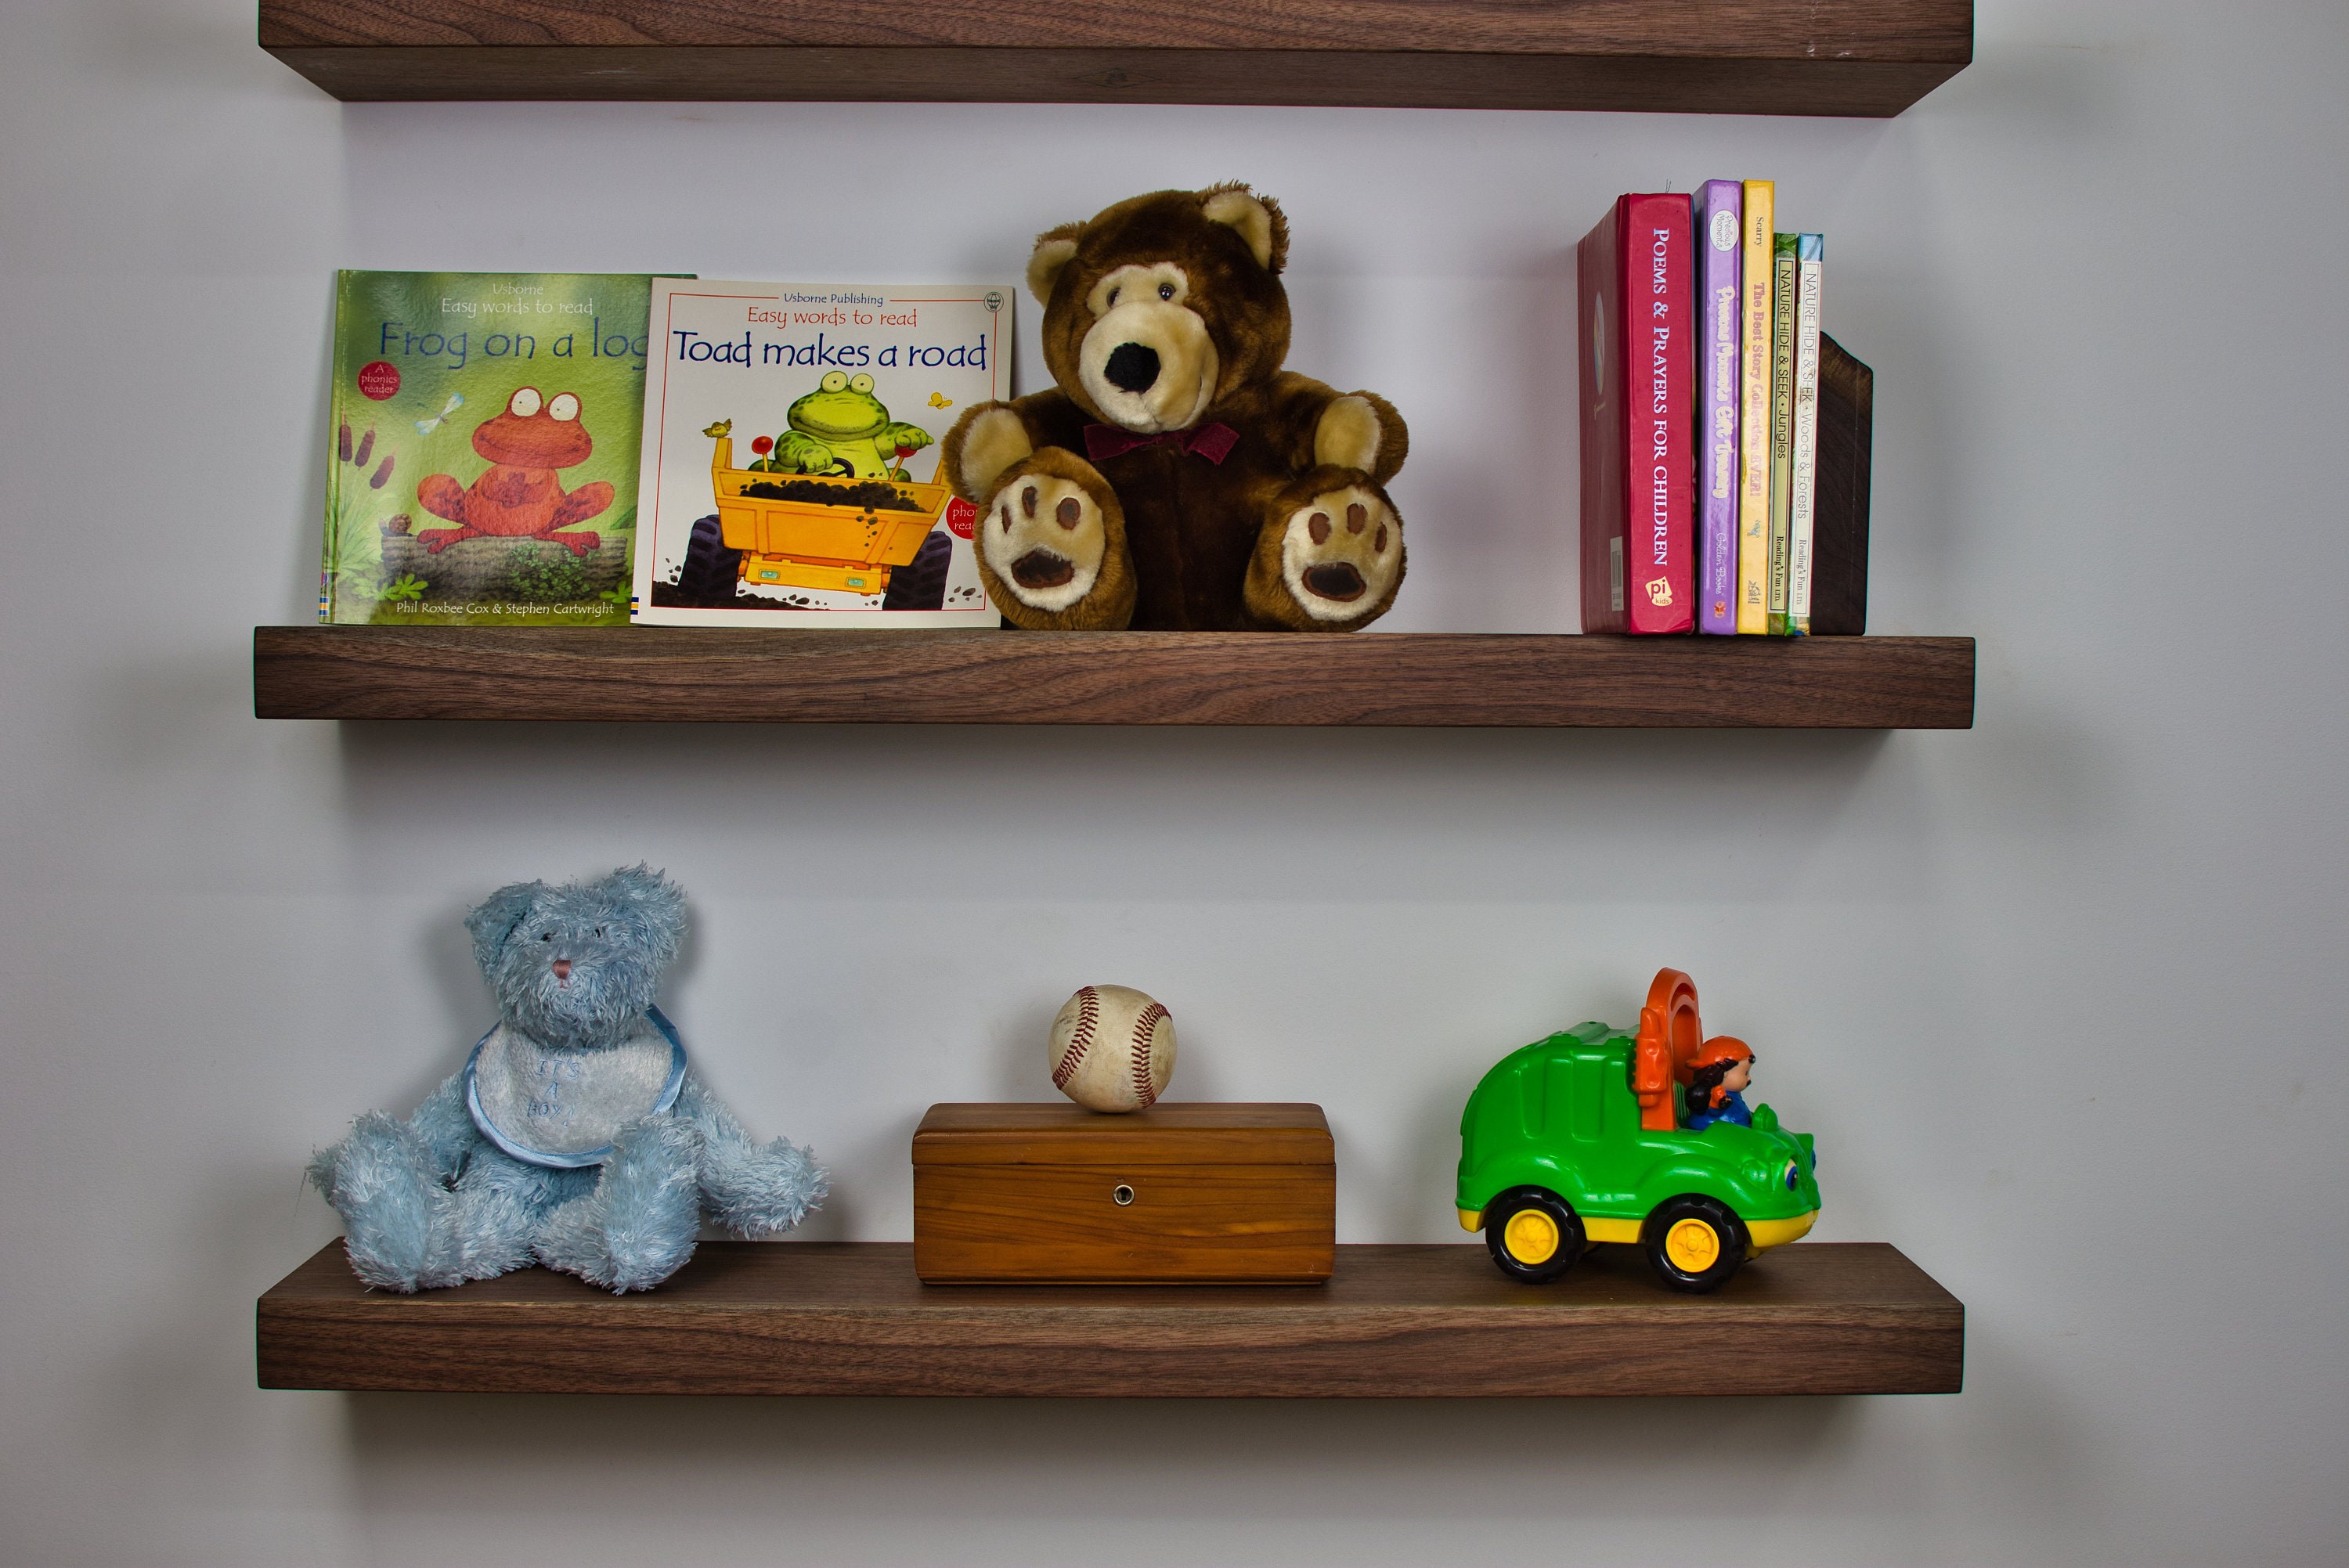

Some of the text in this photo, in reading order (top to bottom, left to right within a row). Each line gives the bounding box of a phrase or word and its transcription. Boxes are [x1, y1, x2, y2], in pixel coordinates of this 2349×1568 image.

[1716, 214, 1725, 248] Moments
[1754, 217, 1764, 247] Scarry
[493, 283, 543, 295] Usborne
[784, 292, 883, 308] Usborne Publishing
[1753, 282, 1765, 308] The
[442, 297, 593, 319] Easy words to read
[748, 306, 918, 330] Easy words to read
[1752, 312, 1764, 341] Best
[381, 322, 467, 369] Frog
[485, 333, 536, 359] on
[553, 333, 574, 358] a
[673, 330, 987, 371] Toad makes a road
[375, 364, 384, 373] A
[1750, 344, 1764, 380] Story
[1776, 269, 1791, 459] NATURE HIDE & SEEK Jungles
[361, 373, 398, 385] phonics
[364, 384, 394, 394] reader
[1653, 228, 1670, 566] POEMS & PRAYERS FOR CHILDREN
[1798, 274, 1817, 519] NATURE HIDE & SEEK Woods & Forests
[953, 505, 977, 520] pho
[1715, 532, 1728, 594] Golden Books
[1774, 536, 1784, 571] Reading's
[1796, 539, 1807, 575] Reading's
[1650, 579, 1665, 598] pi
[1775, 573, 1784, 587] Fun
[1797, 577, 1806, 590] Fun
[396, 601, 615, 618] Phil Roxbee Cox & Stephen Cartwright
[536, 1058, 582, 1080] IT'S
[545, 1079, 558, 1099] A
